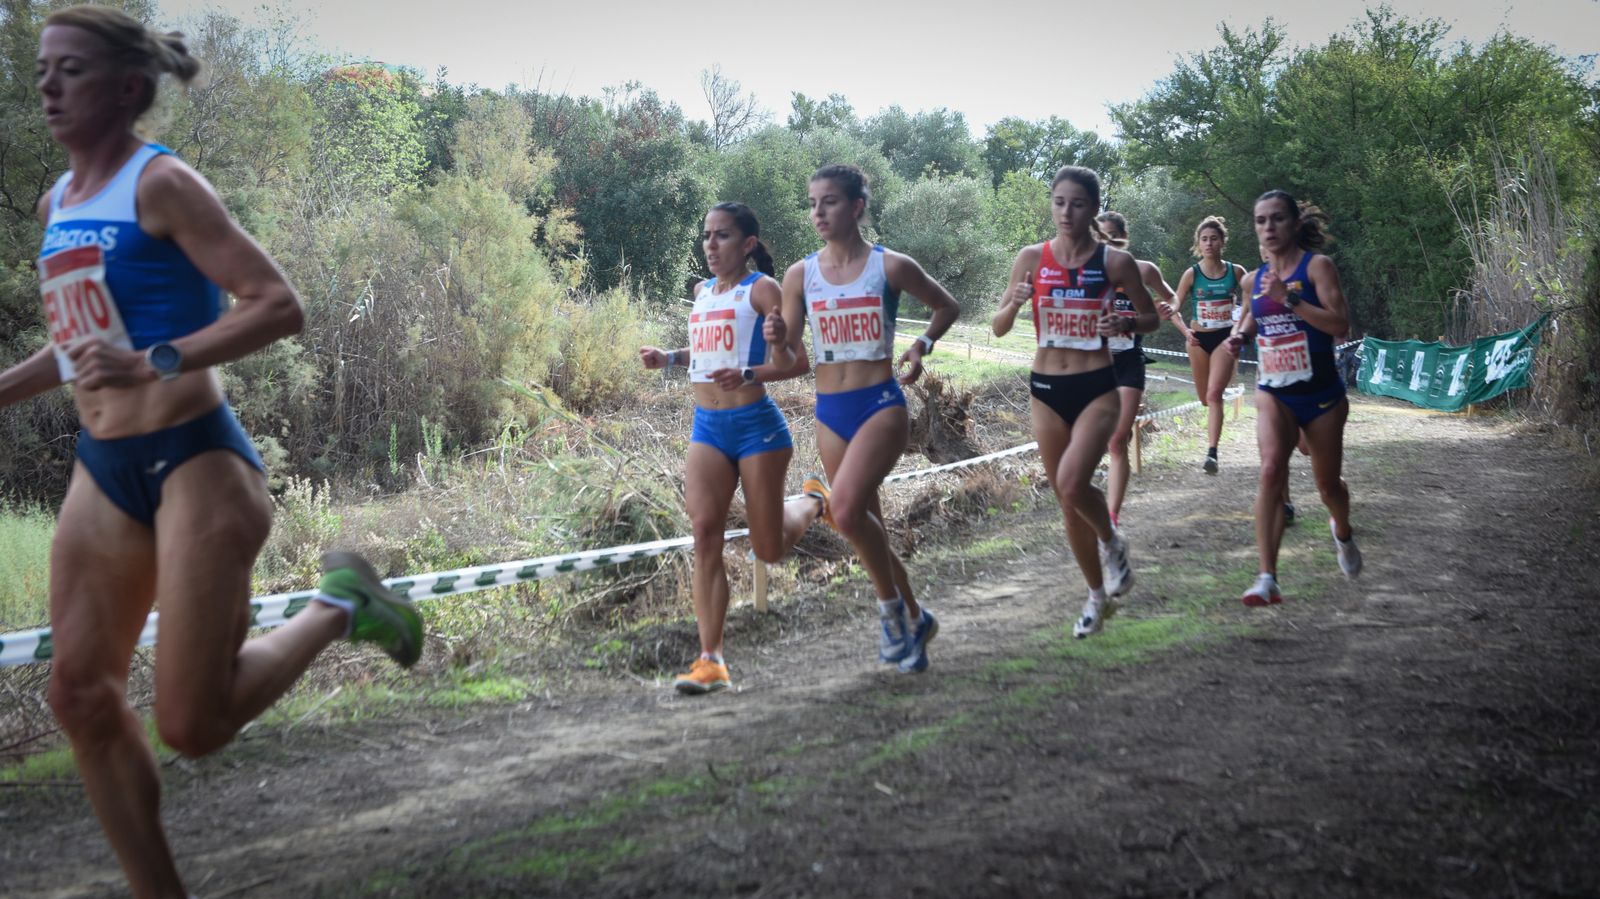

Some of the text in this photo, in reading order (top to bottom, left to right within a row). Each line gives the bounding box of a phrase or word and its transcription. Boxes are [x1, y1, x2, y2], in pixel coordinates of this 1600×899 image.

[44, 279, 110, 344] ELAYO
[1046, 312, 1099, 339] PRIEGO
[692, 324, 734, 353] CAMPO
[819, 311, 881, 344] ROMERO
